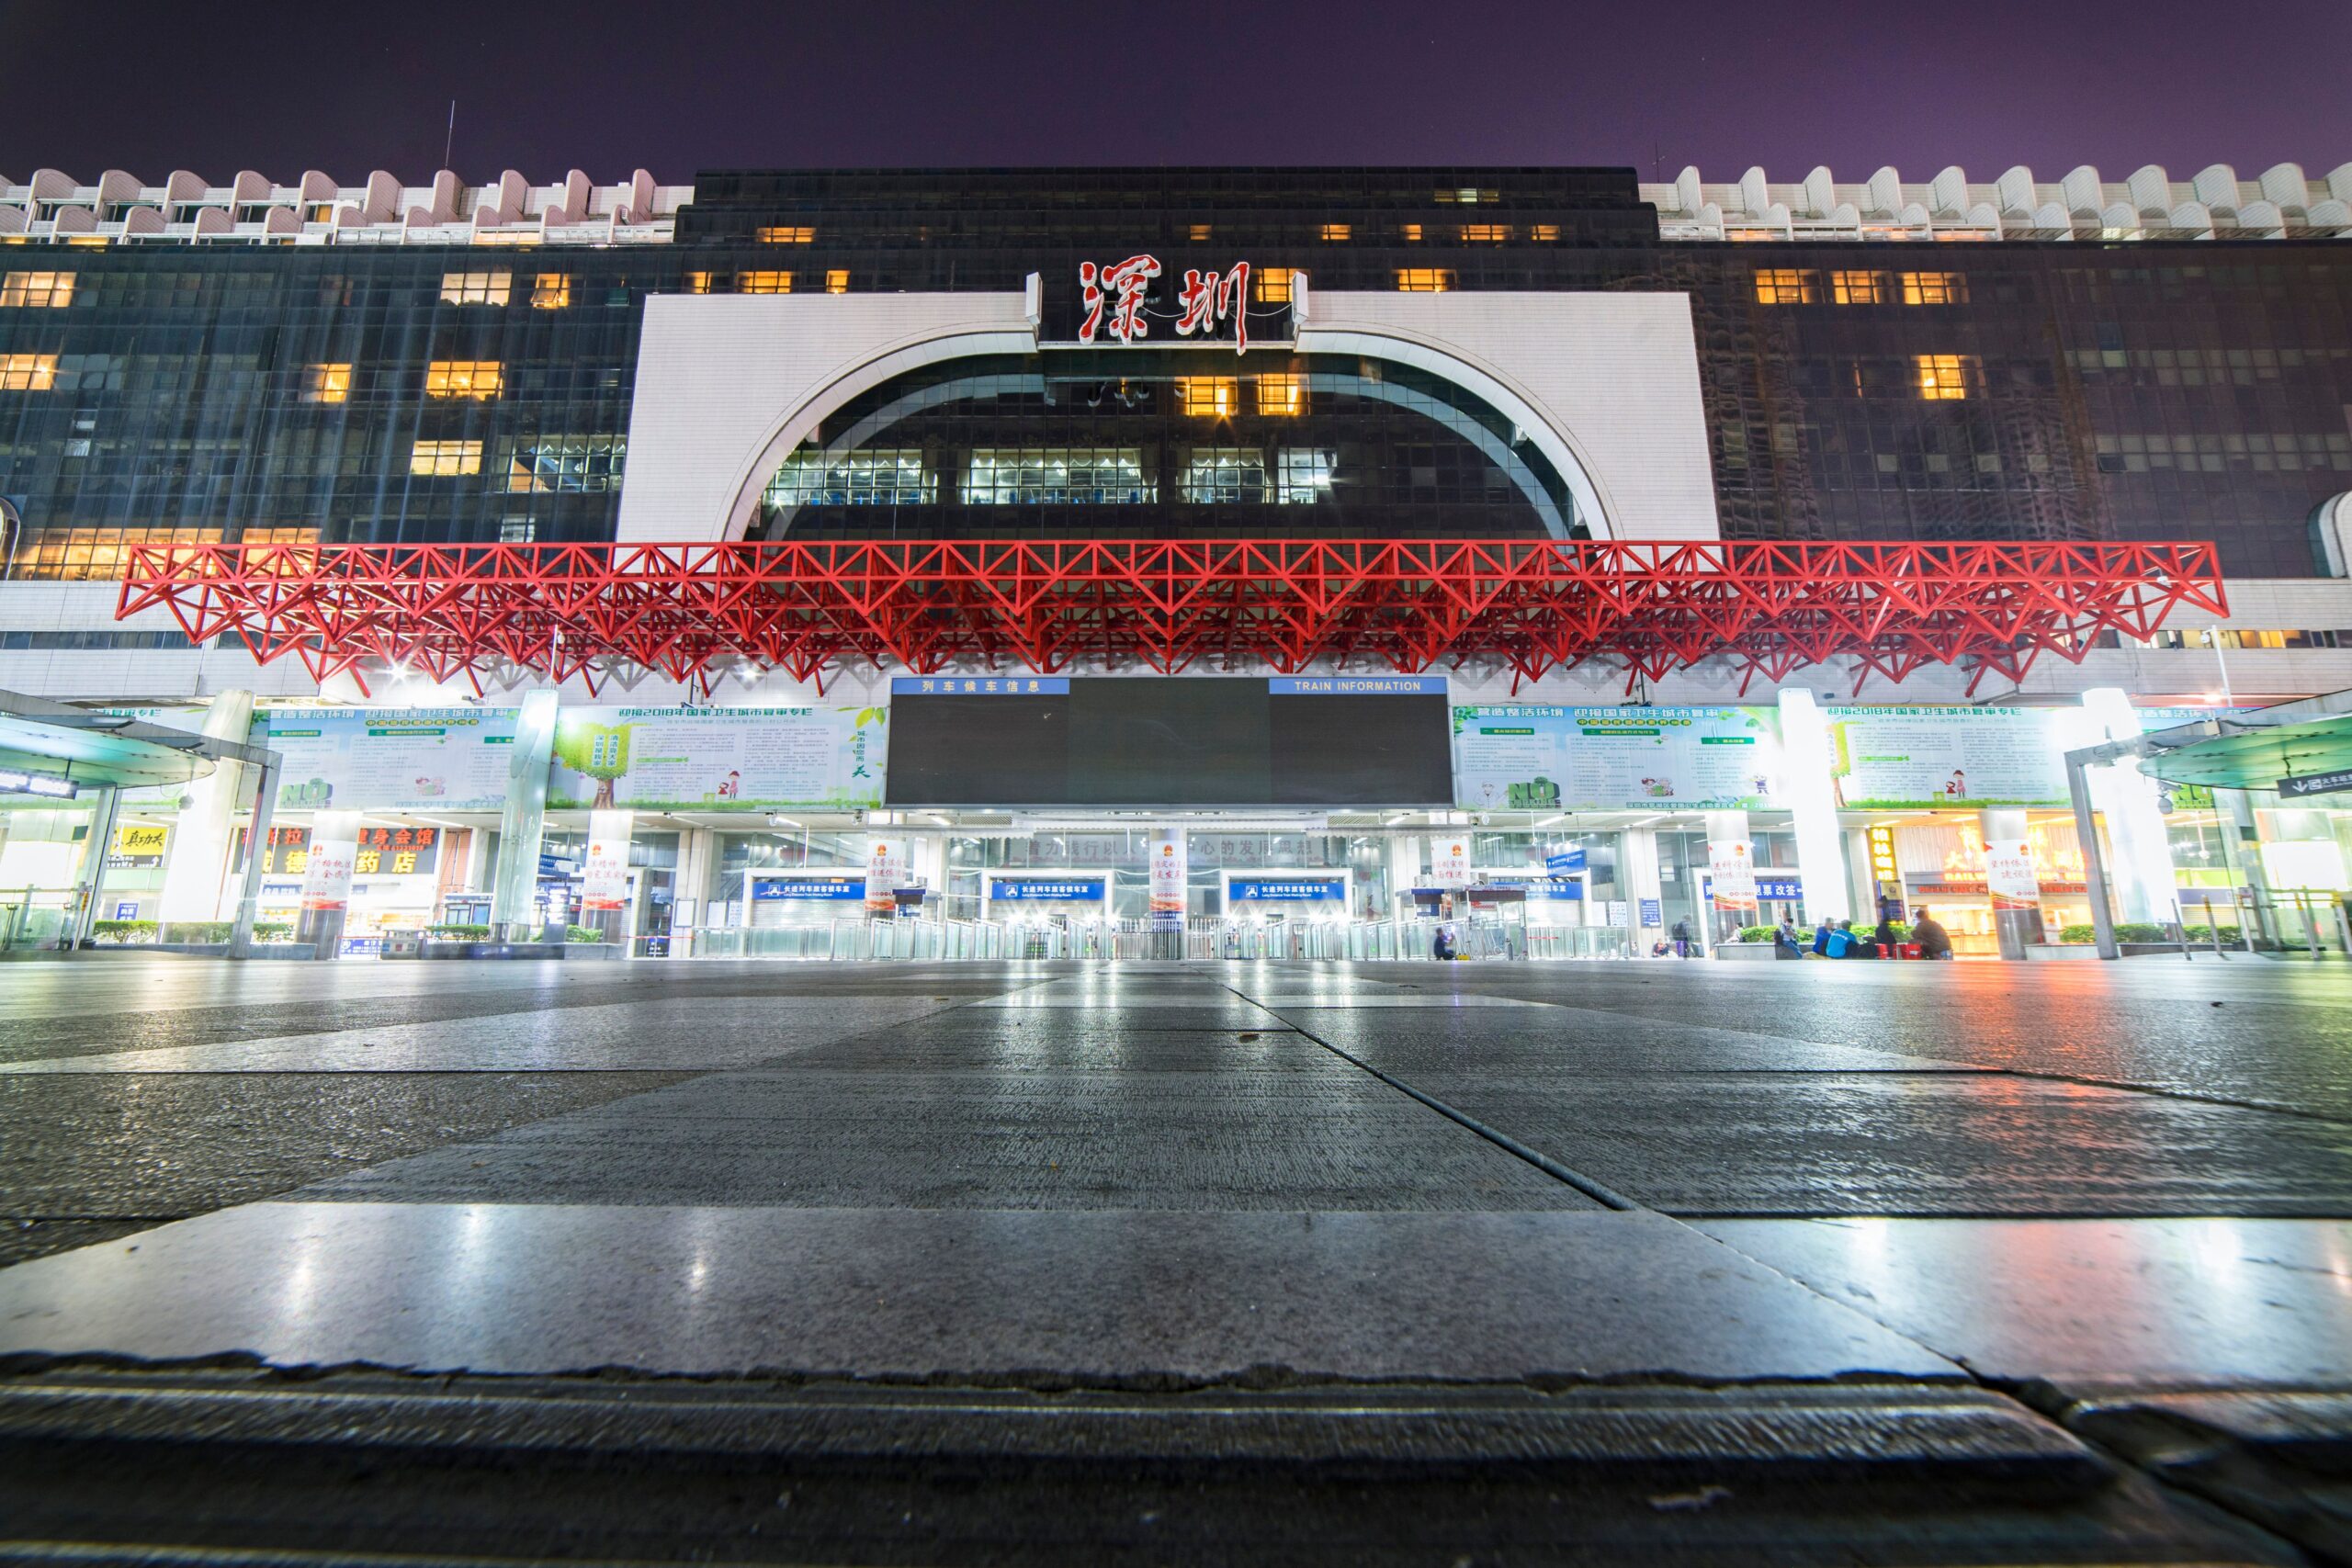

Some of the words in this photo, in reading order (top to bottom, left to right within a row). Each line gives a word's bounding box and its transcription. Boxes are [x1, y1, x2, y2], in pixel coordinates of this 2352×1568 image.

[1079, 254, 1250, 355] 深圳
[922, 681, 1040, 693] 列车候车信息
[1295, 682, 1332, 691] TRAIN
[1337, 682, 1420, 691] INFORMATION
[1477, 707, 1564, 717] 营造整洁环境
[1574, 708, 1719, 718] 迎接国家卫生城市复审
[125, 829, 164, 847] 真功夫
[1775, 885, 1796, 896] 改签
